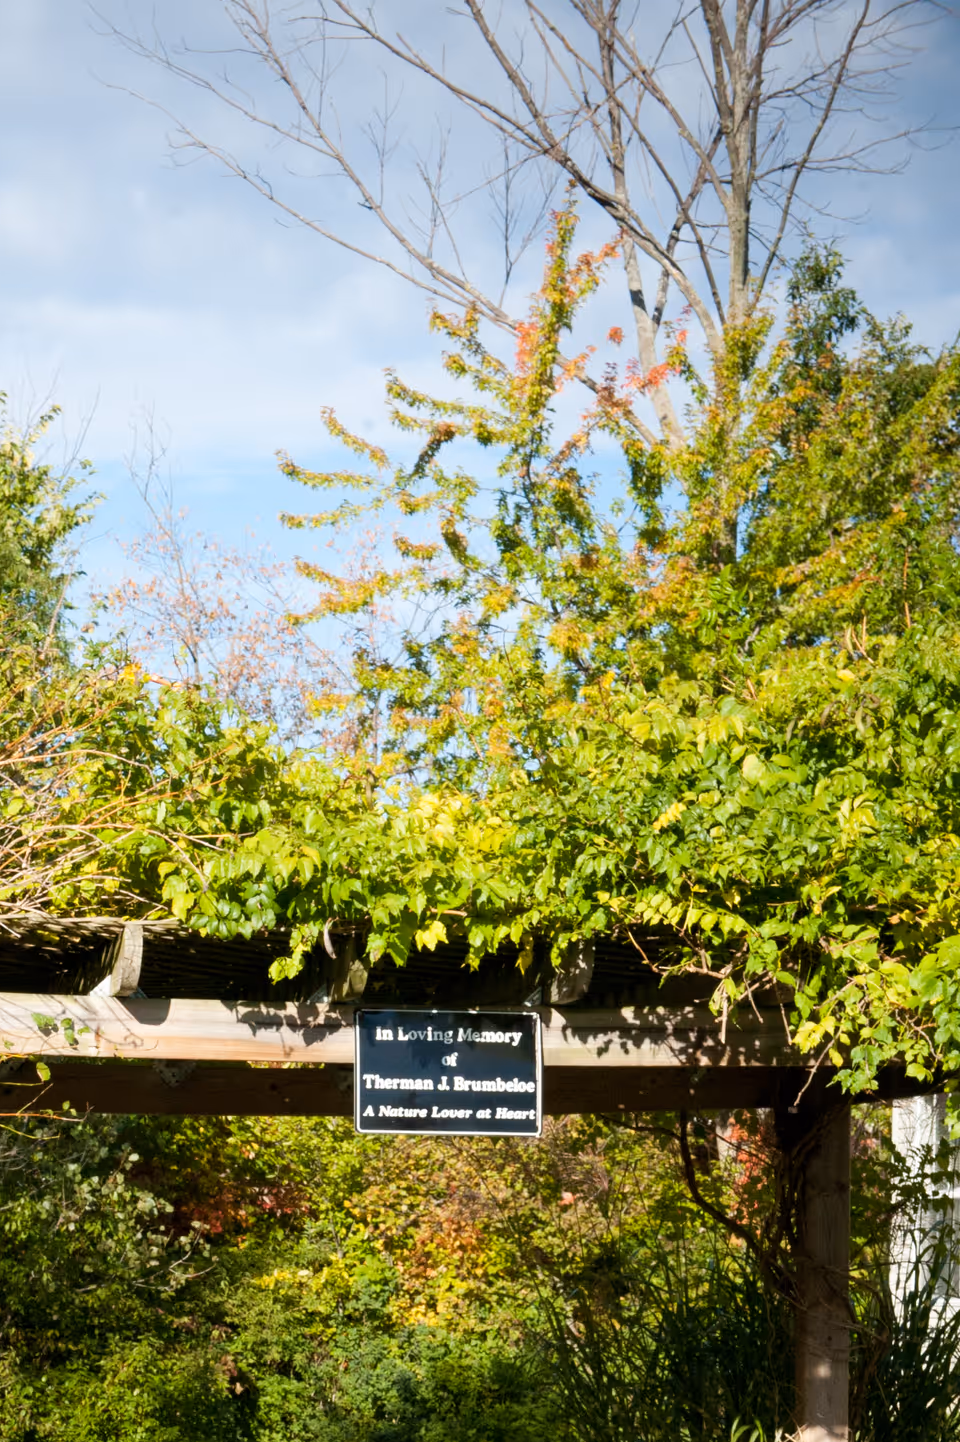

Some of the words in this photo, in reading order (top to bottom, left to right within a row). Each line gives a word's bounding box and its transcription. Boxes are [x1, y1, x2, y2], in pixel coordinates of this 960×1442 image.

[375, 1026, 393, 1041] In
[397, 1026, 453, 1044] Loving
[457, 1028, 522, 1046] Memory
[441, 1052, 458, 1067] of
[362, 1074, 434, 1091] Therman
[437, 1076, 450, 1091] J.
[362, 1105, 375, 1117] A
[378, 1105, 427, 1118] Nature
[431, 1106, 472, 1119] Lover
[476, 1108, 492, 1119] at
[495, 1108, 536, 1120] Heart
